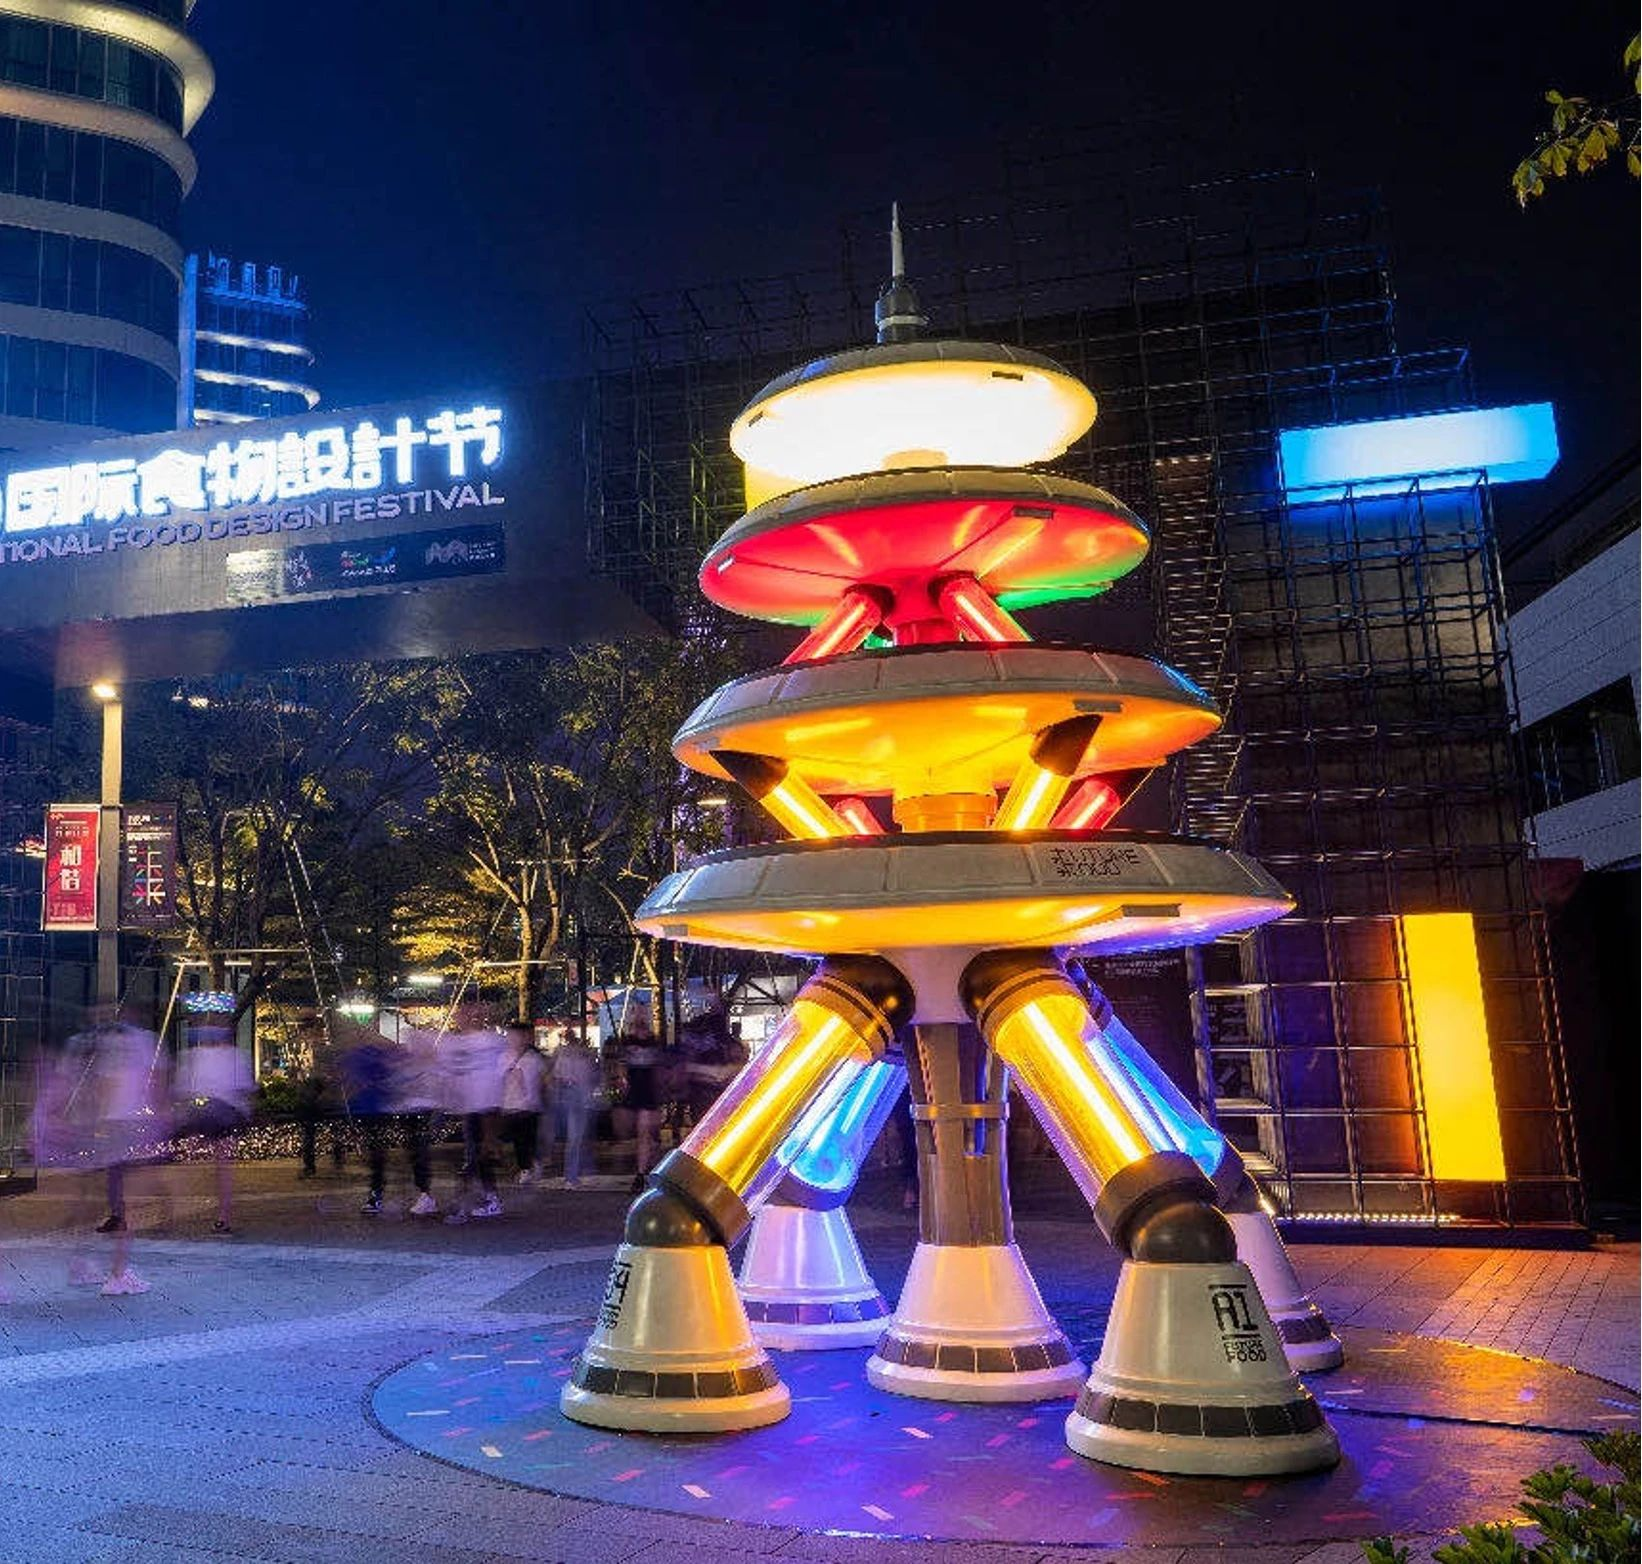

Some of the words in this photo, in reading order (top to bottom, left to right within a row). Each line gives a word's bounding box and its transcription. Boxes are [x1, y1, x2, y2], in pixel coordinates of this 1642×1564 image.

[0, 405, 502, 533] 国际食物設計节
[108, 518, 204, 551] FOOD
[207, 502, 328, 541] DESIGN
[332, 481, 505, 525] FESTIVAL
[1226, 1349, 1266, 1363] FOOD
